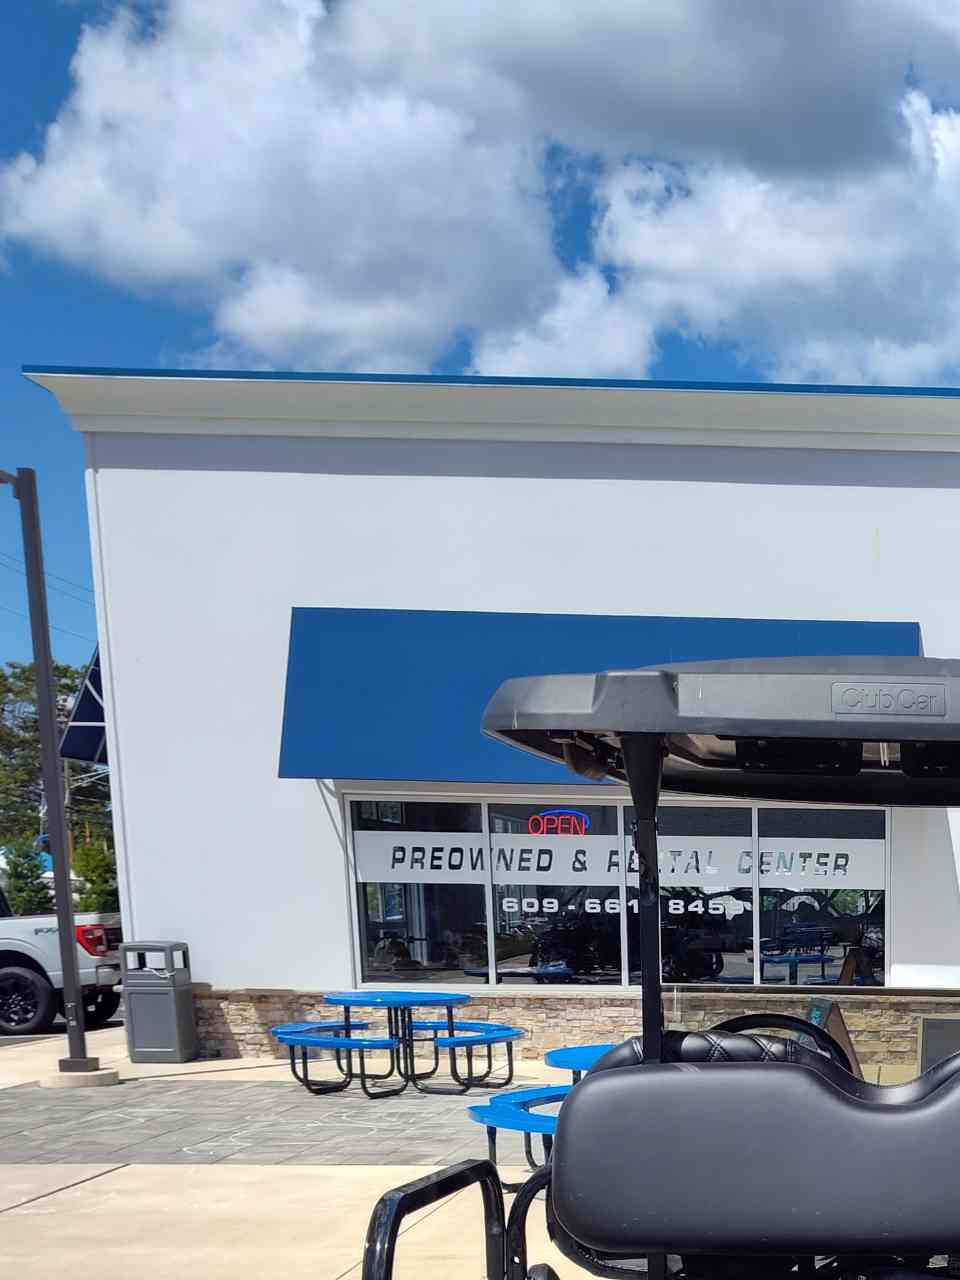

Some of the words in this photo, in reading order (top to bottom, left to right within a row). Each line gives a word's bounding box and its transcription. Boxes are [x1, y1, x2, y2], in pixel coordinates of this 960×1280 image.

[528, 815, 586, 835] OPEN
[391, 846, 553, 872] PREOWNED
[572, 849, 588, 872] &
[607, 850, 720, 874] RETAL
[737, 850, 850, 876] CENTER
